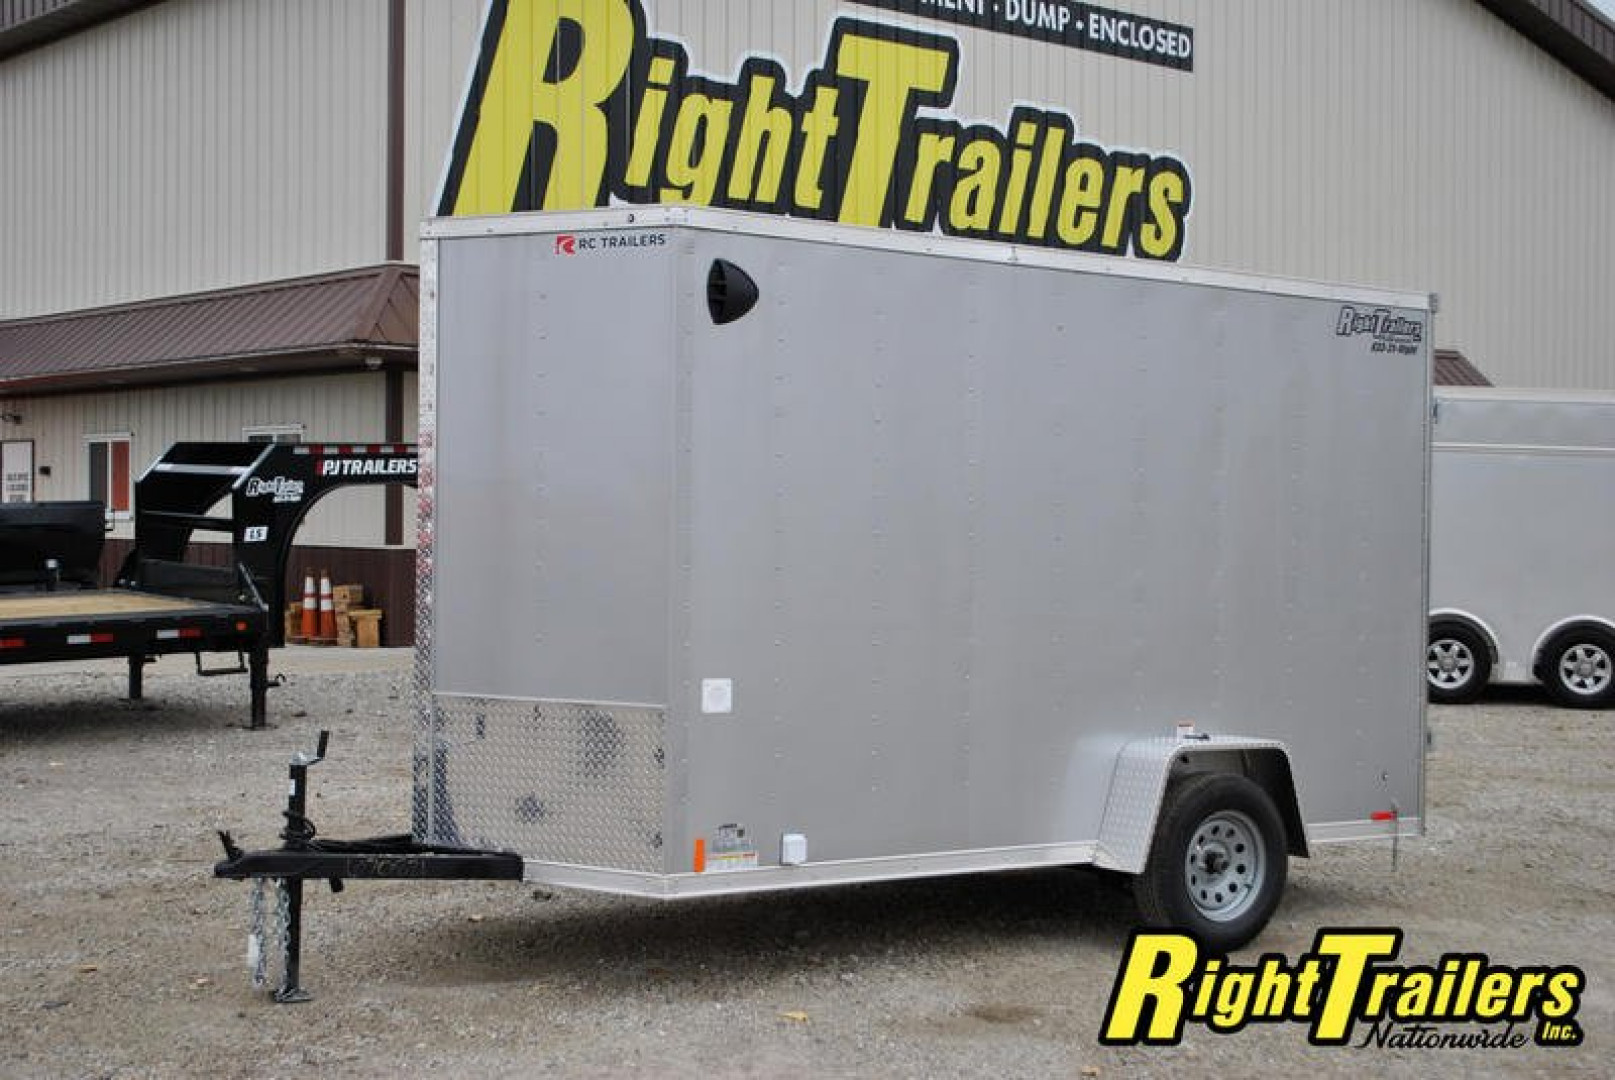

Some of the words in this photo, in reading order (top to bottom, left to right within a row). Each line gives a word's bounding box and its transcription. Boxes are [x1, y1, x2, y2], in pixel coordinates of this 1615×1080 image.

[1004, 0, 1071, 32] DUMP
[1088, 13, 1190, 59] ENCLOSED
[578, 237, 597, 249] RC
[600, 232, 667, 249] TRAILERS
[322, 458, 340, 476] PJ
[341, 458, 418, 475] TRAILERS
